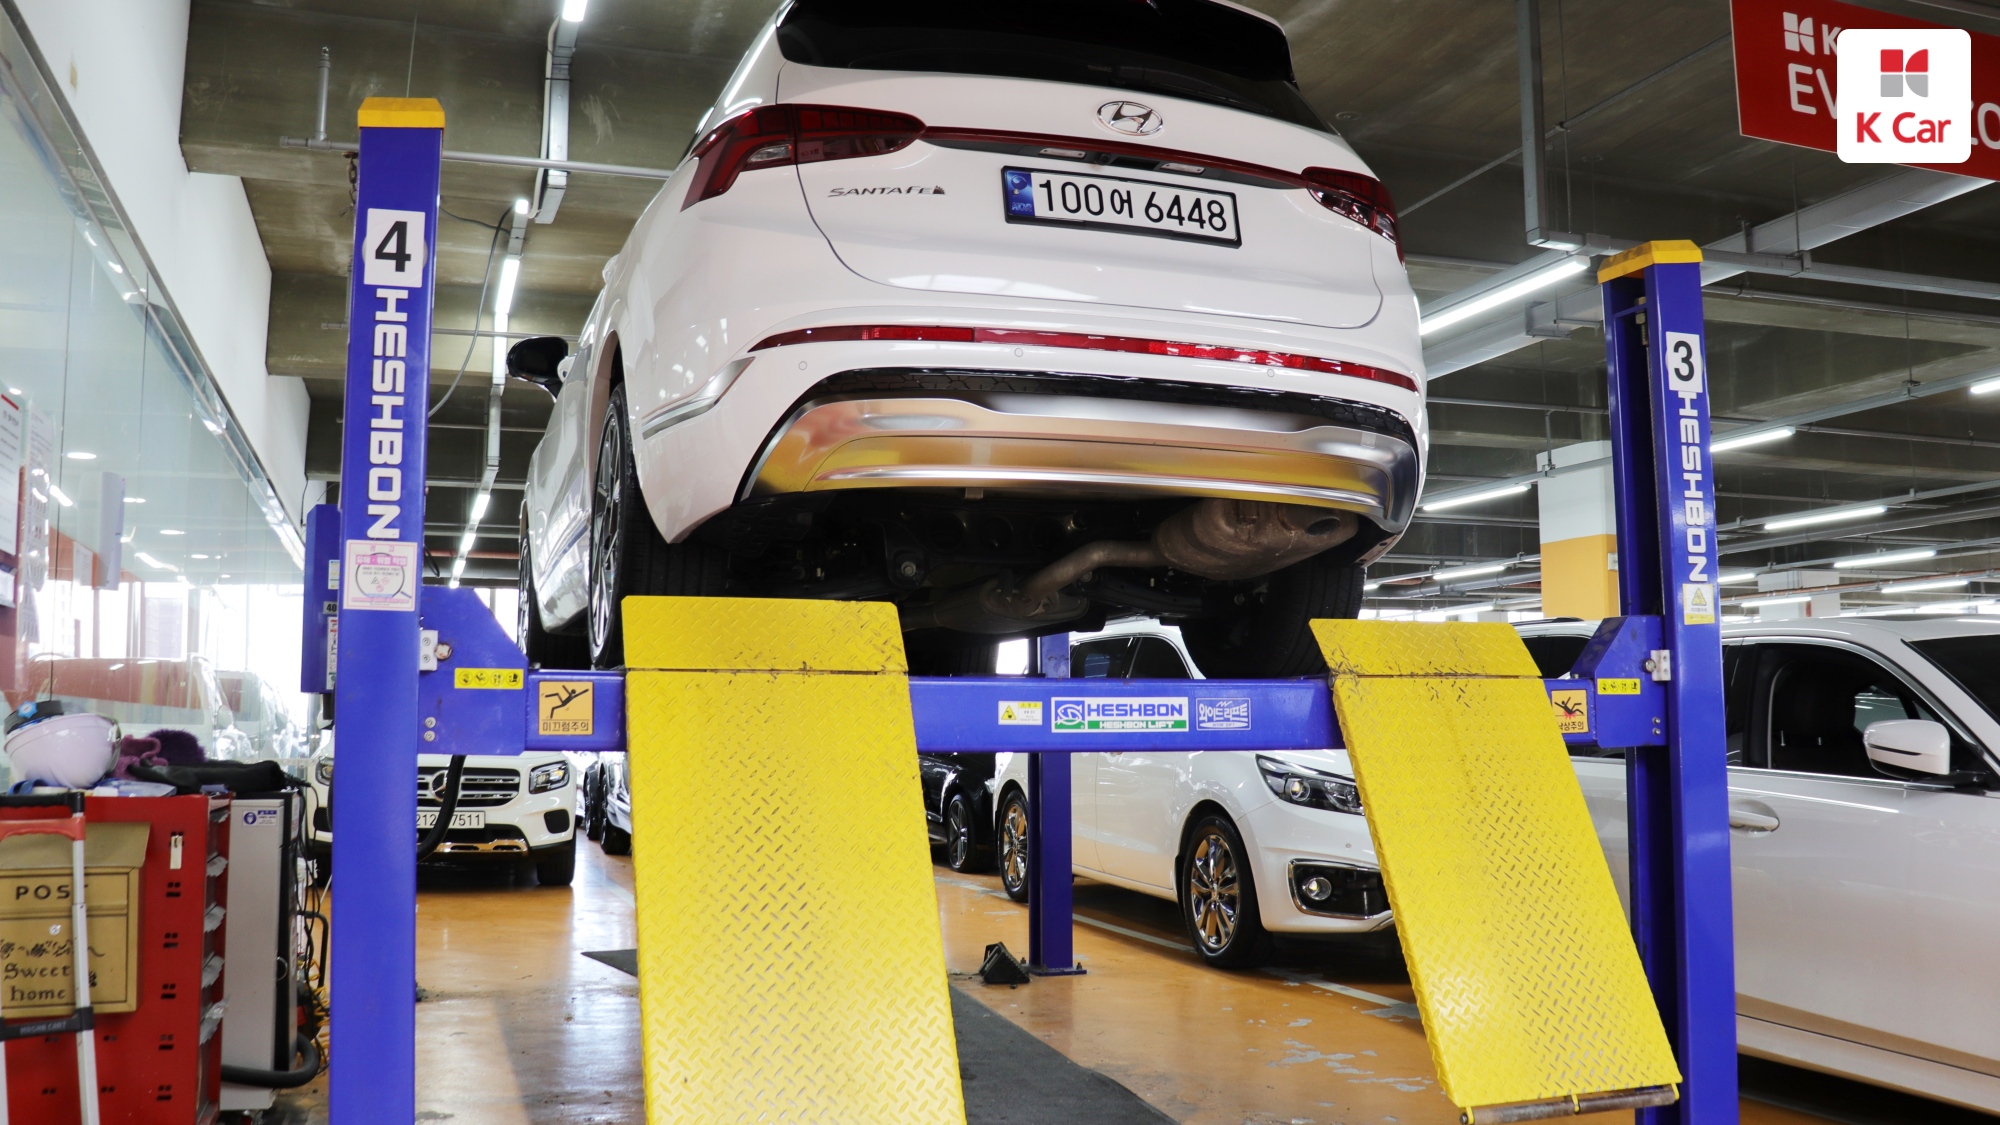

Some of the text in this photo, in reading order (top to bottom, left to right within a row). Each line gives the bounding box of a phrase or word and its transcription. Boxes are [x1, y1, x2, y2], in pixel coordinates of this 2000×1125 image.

[1039, 179, 1228, 232] 100어 6448
[375, 220, 411, 272] 4
[1673, 340, 1695, 382] 3
[366, 288, 409, 539] HESHBON
[1678, 390, 1709, 582] HESHBON
[1087, 704, 1183, 717] HESHBON
[1198, 703, 1249, 722] 와이드리프트
[543, 721, 589, 732] 미끄럼주의
[1100, 720, 1175, 729] HESHBON LIFT
[453, 814, 480, 826] 7511
[16, 884, 88, 900] POS
[4, 962, 71, 981] Sweet
[11, 985, 66, 1001] home
